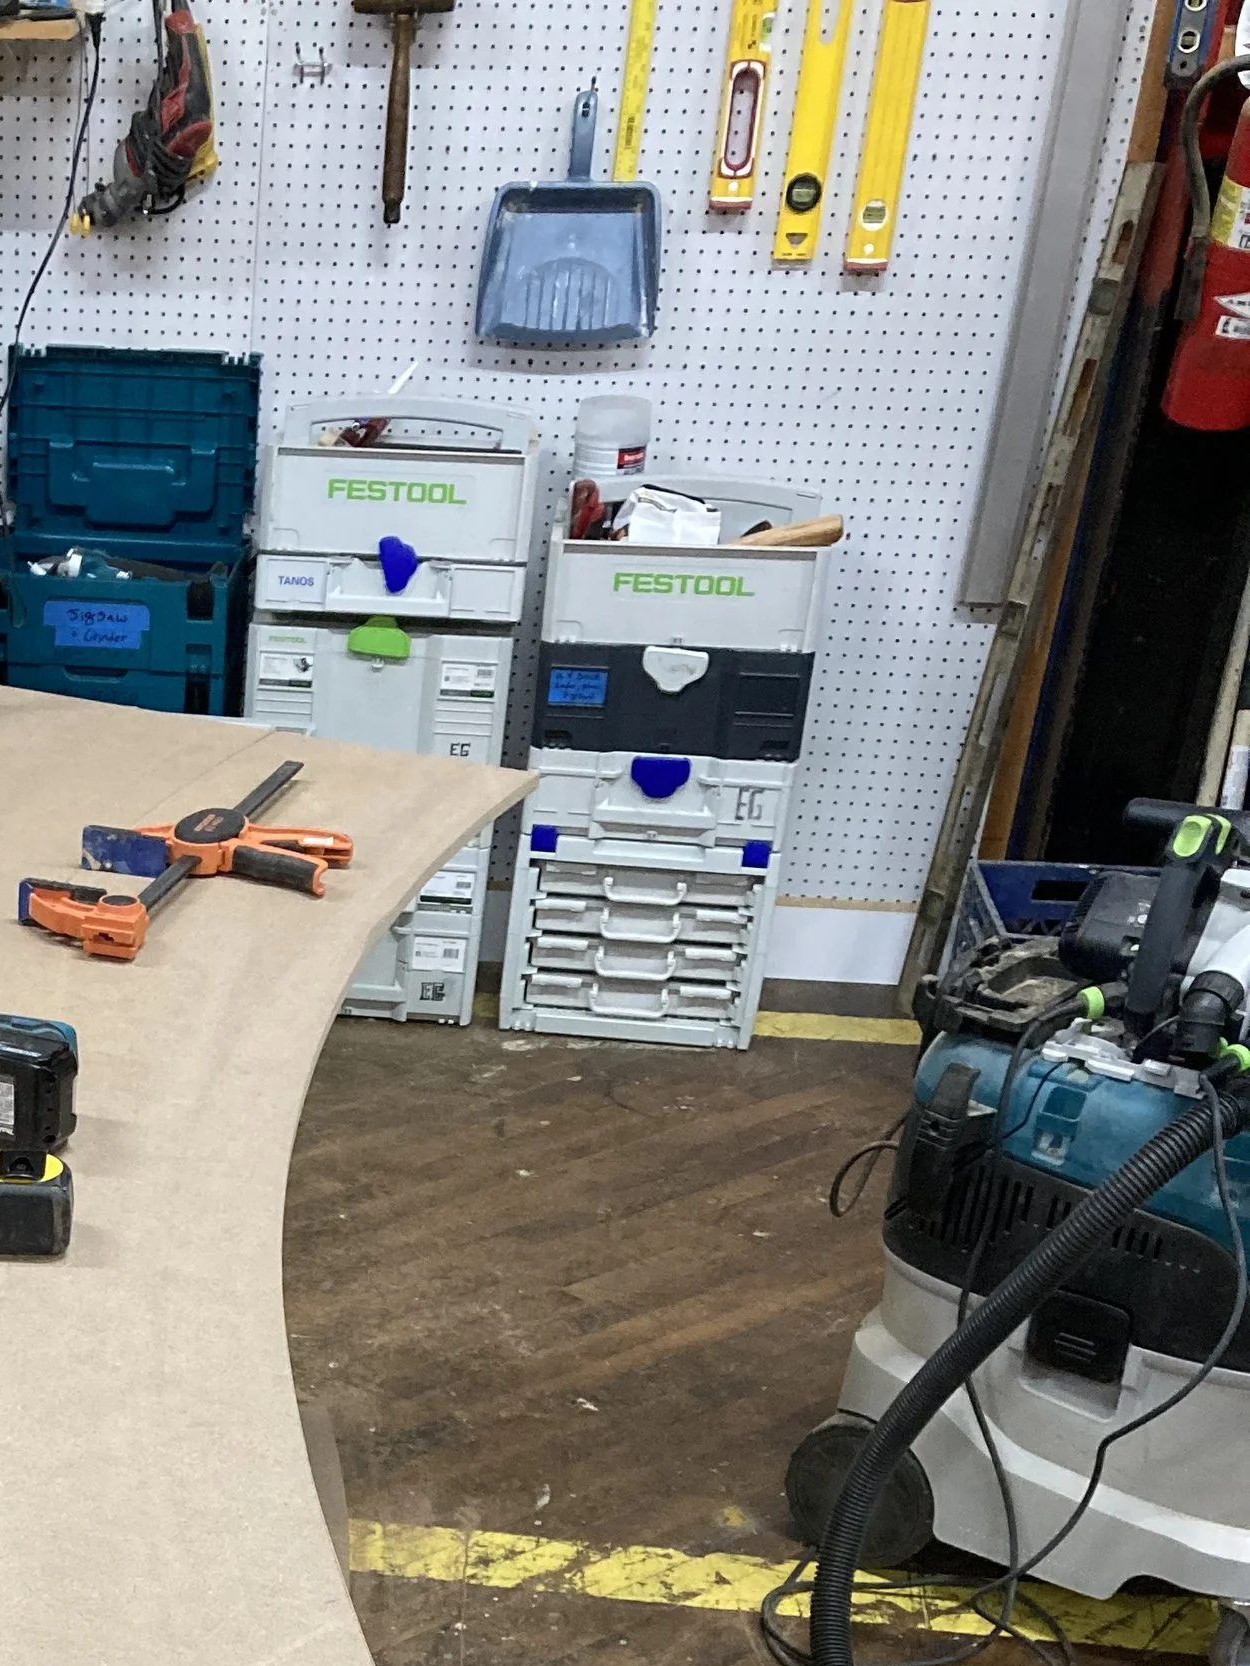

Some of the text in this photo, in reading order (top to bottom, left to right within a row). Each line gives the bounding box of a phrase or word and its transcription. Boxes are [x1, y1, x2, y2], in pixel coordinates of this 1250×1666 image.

[327, 478, 467, 505] FESTOOL
[277, 575, 315, 586] TANOS
[613, 572, 756, 597] FESTOOL
[450, 742, 471, 757] EG
